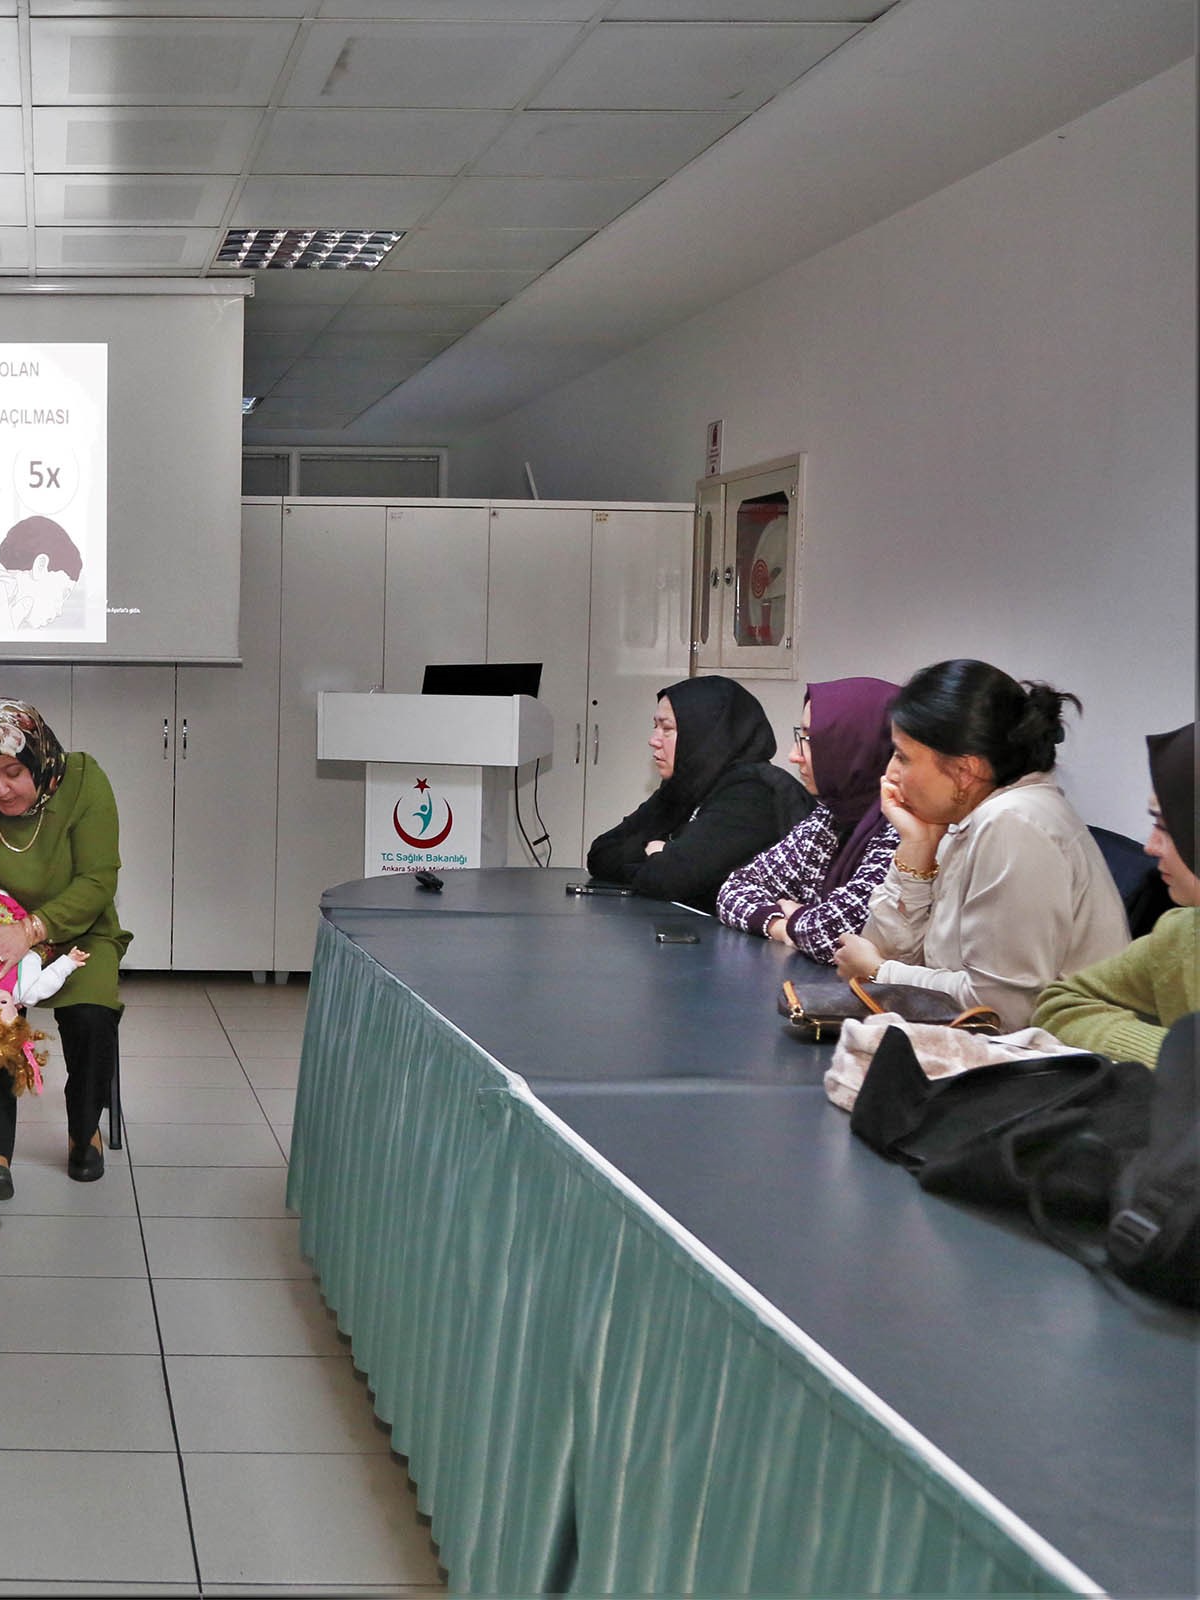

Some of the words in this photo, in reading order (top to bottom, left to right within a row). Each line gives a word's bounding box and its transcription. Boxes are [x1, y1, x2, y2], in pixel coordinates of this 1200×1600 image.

[0, 408, 70, 428] AÇILMASI
[28, 460, 61, 489] 5x
[395, 852, 424, 864] Sağlık
[425, 853, 468, 865] Bakanlığı
